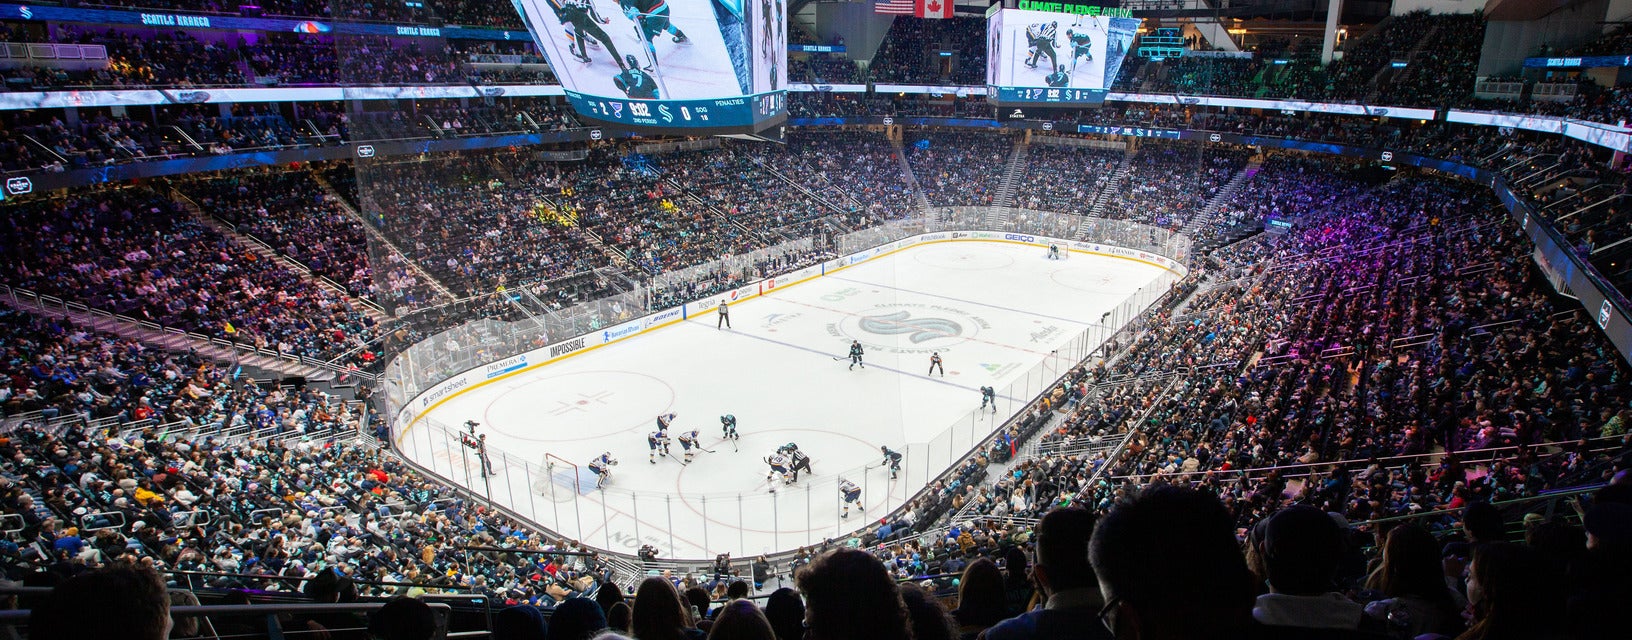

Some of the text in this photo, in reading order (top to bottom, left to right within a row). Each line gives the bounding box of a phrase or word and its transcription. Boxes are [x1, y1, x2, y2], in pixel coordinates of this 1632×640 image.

[1019, 0, 1133, 17] CLIMATE PLEDGE ARENA
[141, 13, 210, 28] SEATTLE KRAKEN
[397, 26, 419, 35] SEATTLE
[1026, 88, 1031, 99] 2
[599, 102, 609, 115] 2
[628, 102, 651, 117] 9:02
[681, 106, 691, 120] 0
[1005, 233, 1034, 243] GEICO
[654, 309, 680, 322] BOEING
[550, 337, 585, 358] IMPOSSIBLE
[486, 358, 518, 372] PREMERA
[429, 377, 468, 402] smartsheet
